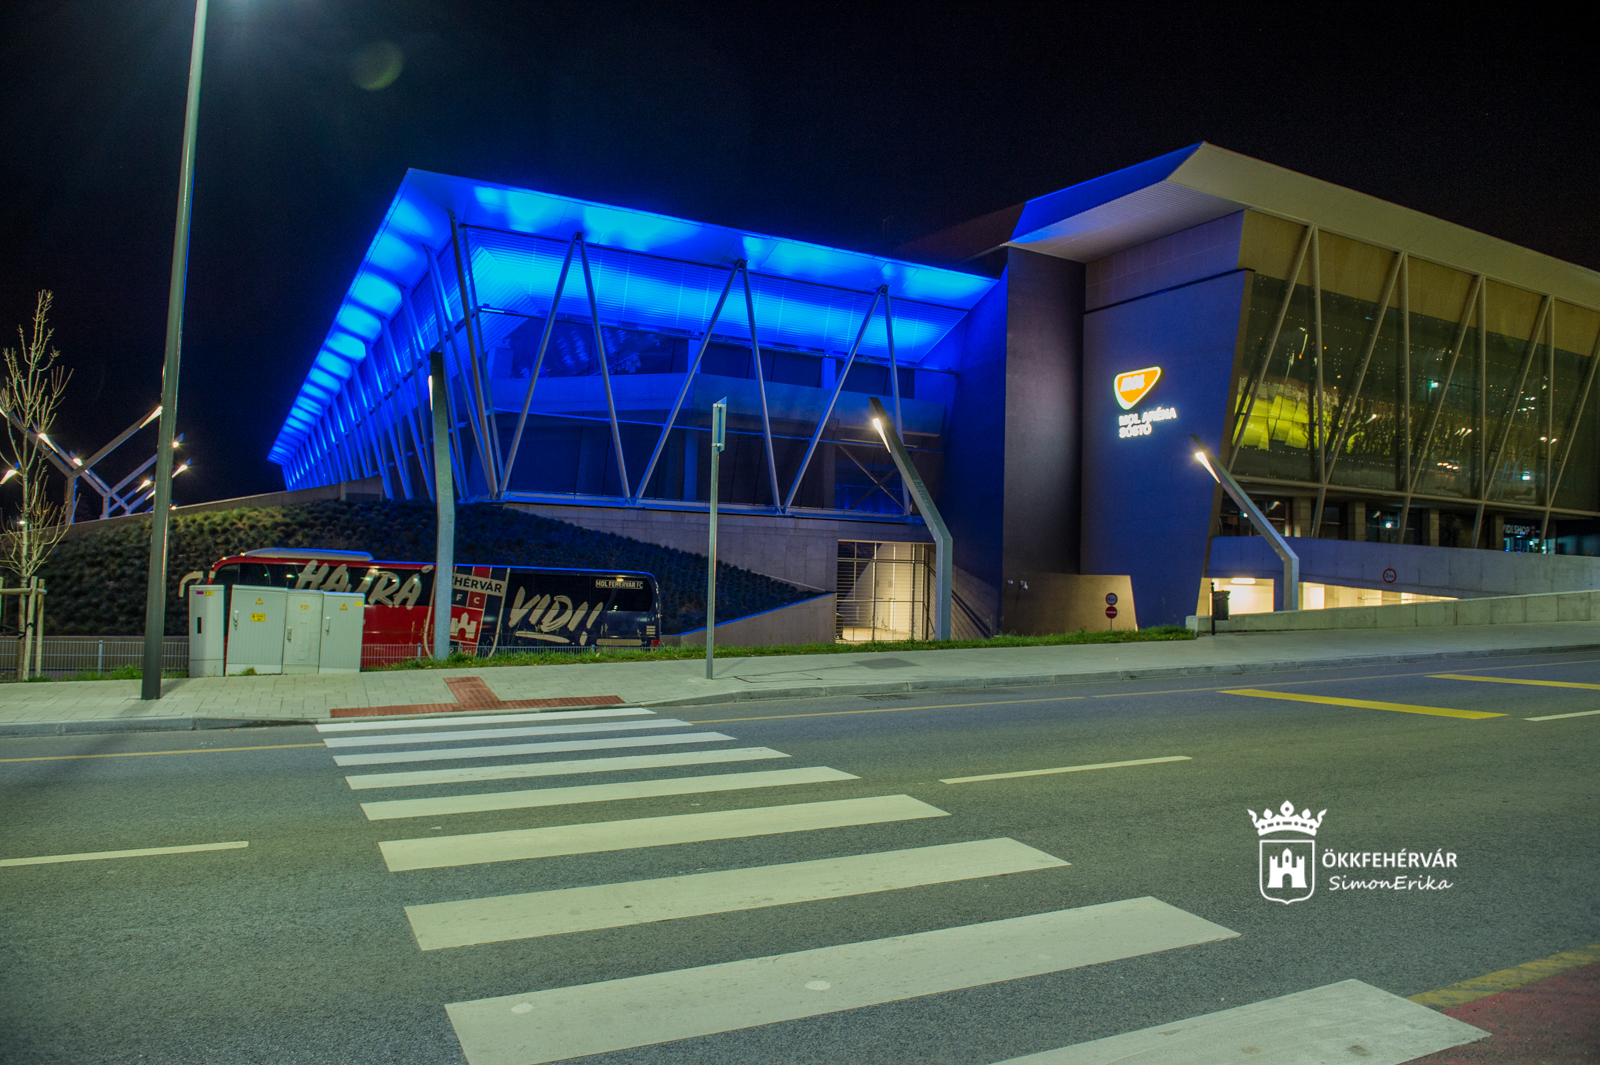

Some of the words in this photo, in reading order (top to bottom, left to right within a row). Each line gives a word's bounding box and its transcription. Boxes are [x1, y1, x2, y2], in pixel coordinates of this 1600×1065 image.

[1514, 525, 1530, 535] SHOP
[595, 579, 608, 589] MOL
[636, 581, 644, 591] FC
[455, 593, 463, 602] F
[473, 597, 481, 605] C
